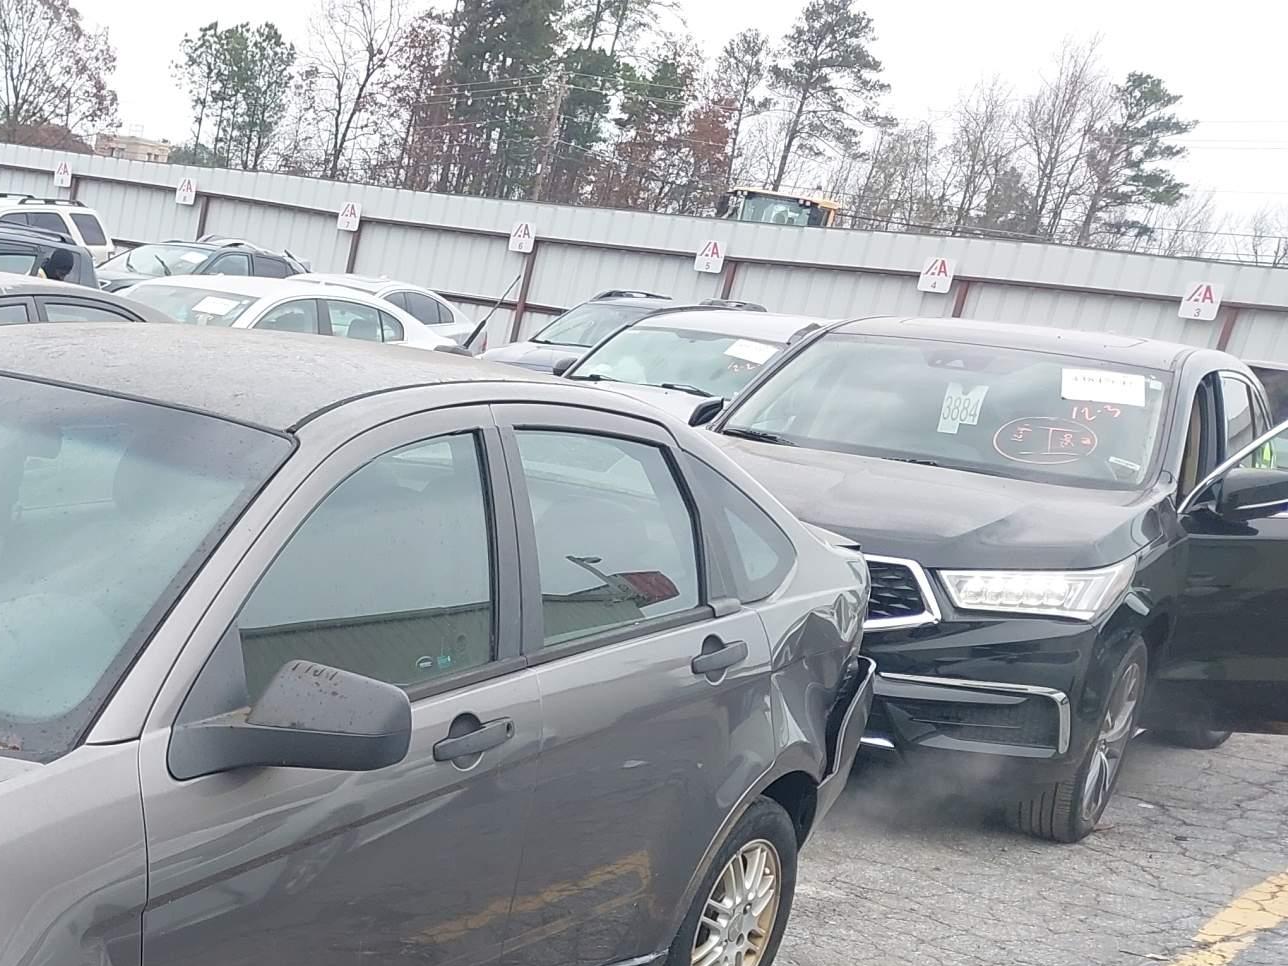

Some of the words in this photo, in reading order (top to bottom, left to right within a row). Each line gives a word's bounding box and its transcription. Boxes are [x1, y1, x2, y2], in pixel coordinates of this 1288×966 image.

[704, 261, 711, 271] 5
[930, 280, 937, 289] 4
[1193, 307, 1201, 318] 3
[943, 396, 980, 422] 3884
